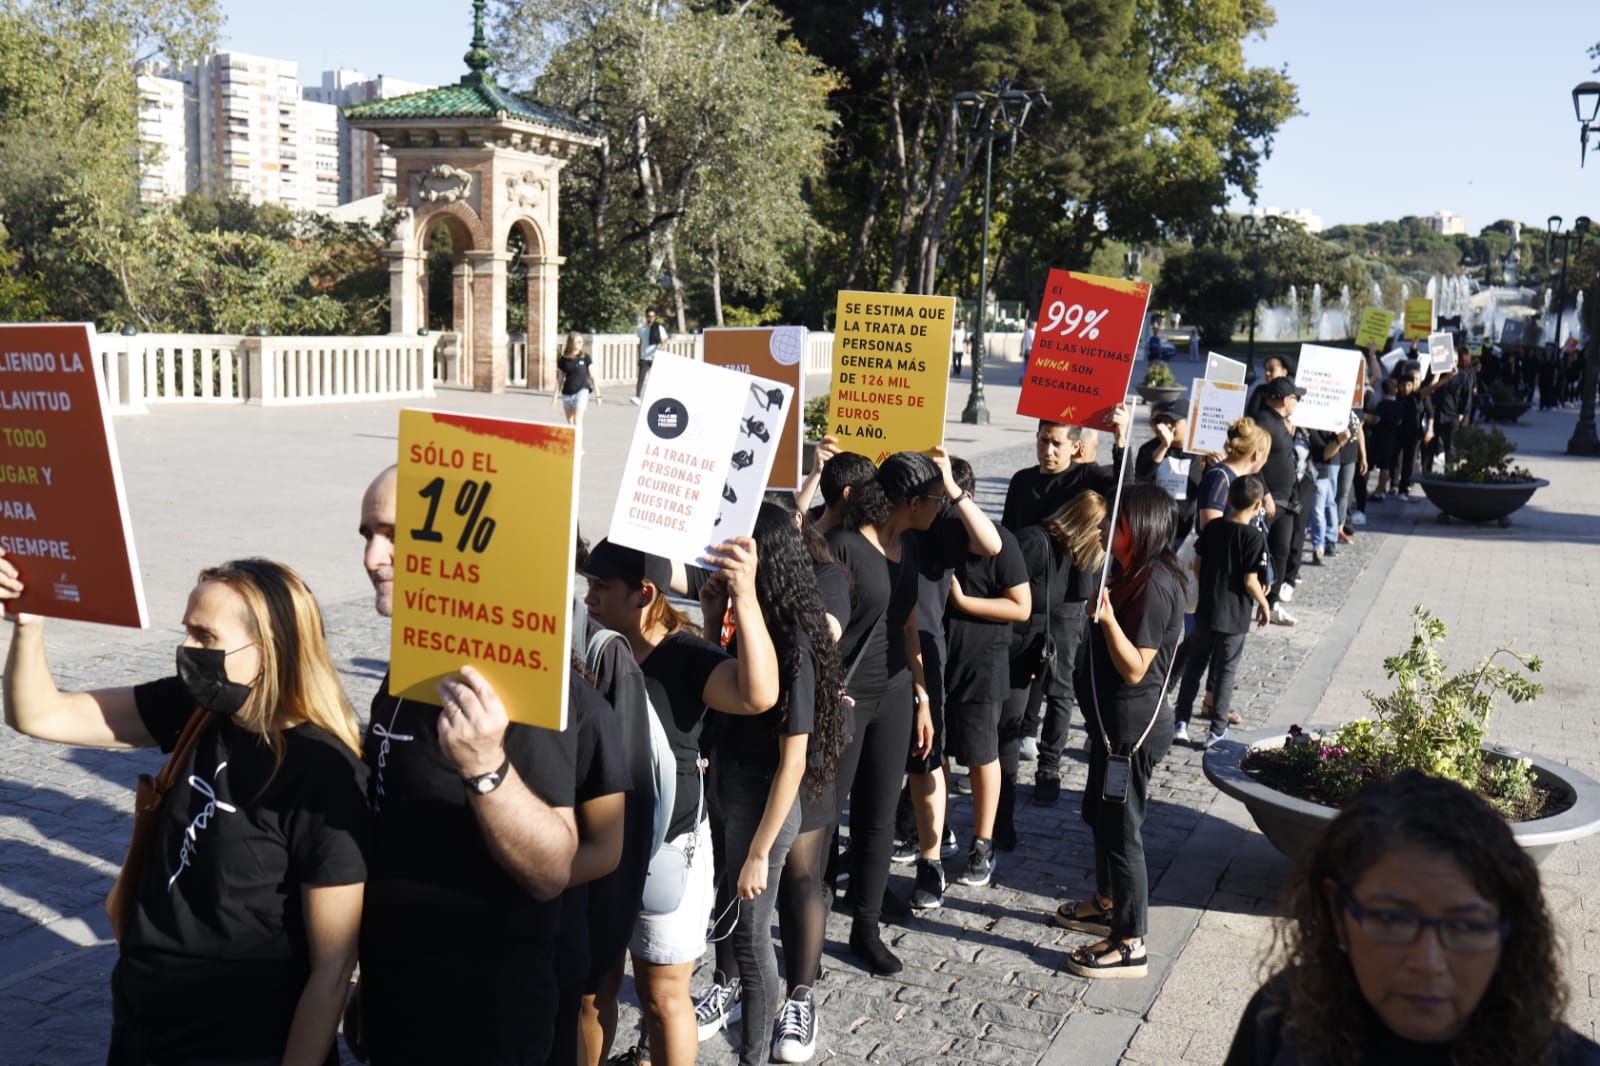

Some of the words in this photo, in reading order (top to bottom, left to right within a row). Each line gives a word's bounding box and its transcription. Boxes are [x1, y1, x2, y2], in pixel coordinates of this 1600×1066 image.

[845, 302, 862, 314] SE
[865, 304, 914, 318] ESTIMA
[918, 308, 946, 320] QUE
[1041, 300, 1109, 340] 99%
[844, 320, 860, 332] LA
[864, 322, 906, 335] TRATA
[910, 325, 928, 337] DE
[842, 338, 913, 354] PERSONAS
[1039, 339, 1053, 349] DE
[1056, 342, 1077, 353] LAS
[1080, 344, 1131, 363] VÍCTIMAS
[60, 352, 85, 373] LA
[841, 355, 893, 370] GENERA
[897, 358, 926, 372] MÁS
[1035, 357, 1070, 372] NUNCA
[1071, 365, 1094, 376] SON
[840, 373, 856, 384] DE
[861, 374, 884, 386] 126
[888, 376, 911, 389] MIL
[1031, 376, 1102, 397] RESCATADAS.
[0, 390, 71, 411] LAVITUD
[838, 390, 903, 406] MILLONES
[907, 396, 925, 408] DE
[837, 407, 880, 421] EUROS
[2, 428, 47, 449] TODO
[835, 424, 852, 436] AL
[855, 424, 887, 440] AÑO.
[410, 441, 464, 469] SÓLO
[472, 453, 497, 473] EL
[645, 443, 660, 457] LA
[663, 448, 697, 468] TRATA
[701, 458, 716, 472] DE
[42, 466, 52, 485] Y
[641, 459, 702, 485] PERSONAS
[637, 475, 683, 497] OCURRE
[684, 488, 700, 502] EN
[633, 490, 693, 517] NUESTRAS
[410, 476, 497, 554] 1%
[628, 506, 689, 533] CIUDADES.
[0, 535, 76, 560] SIEMPRE.
[406, 554, 432, 577] DE
[439, 560, 481, 584] LAS
[404, 588, 504, 625] VÍCTIMAS
[512, 609, 556, 635] SON
[403, 627, 549, 672] RESCATADAS.
